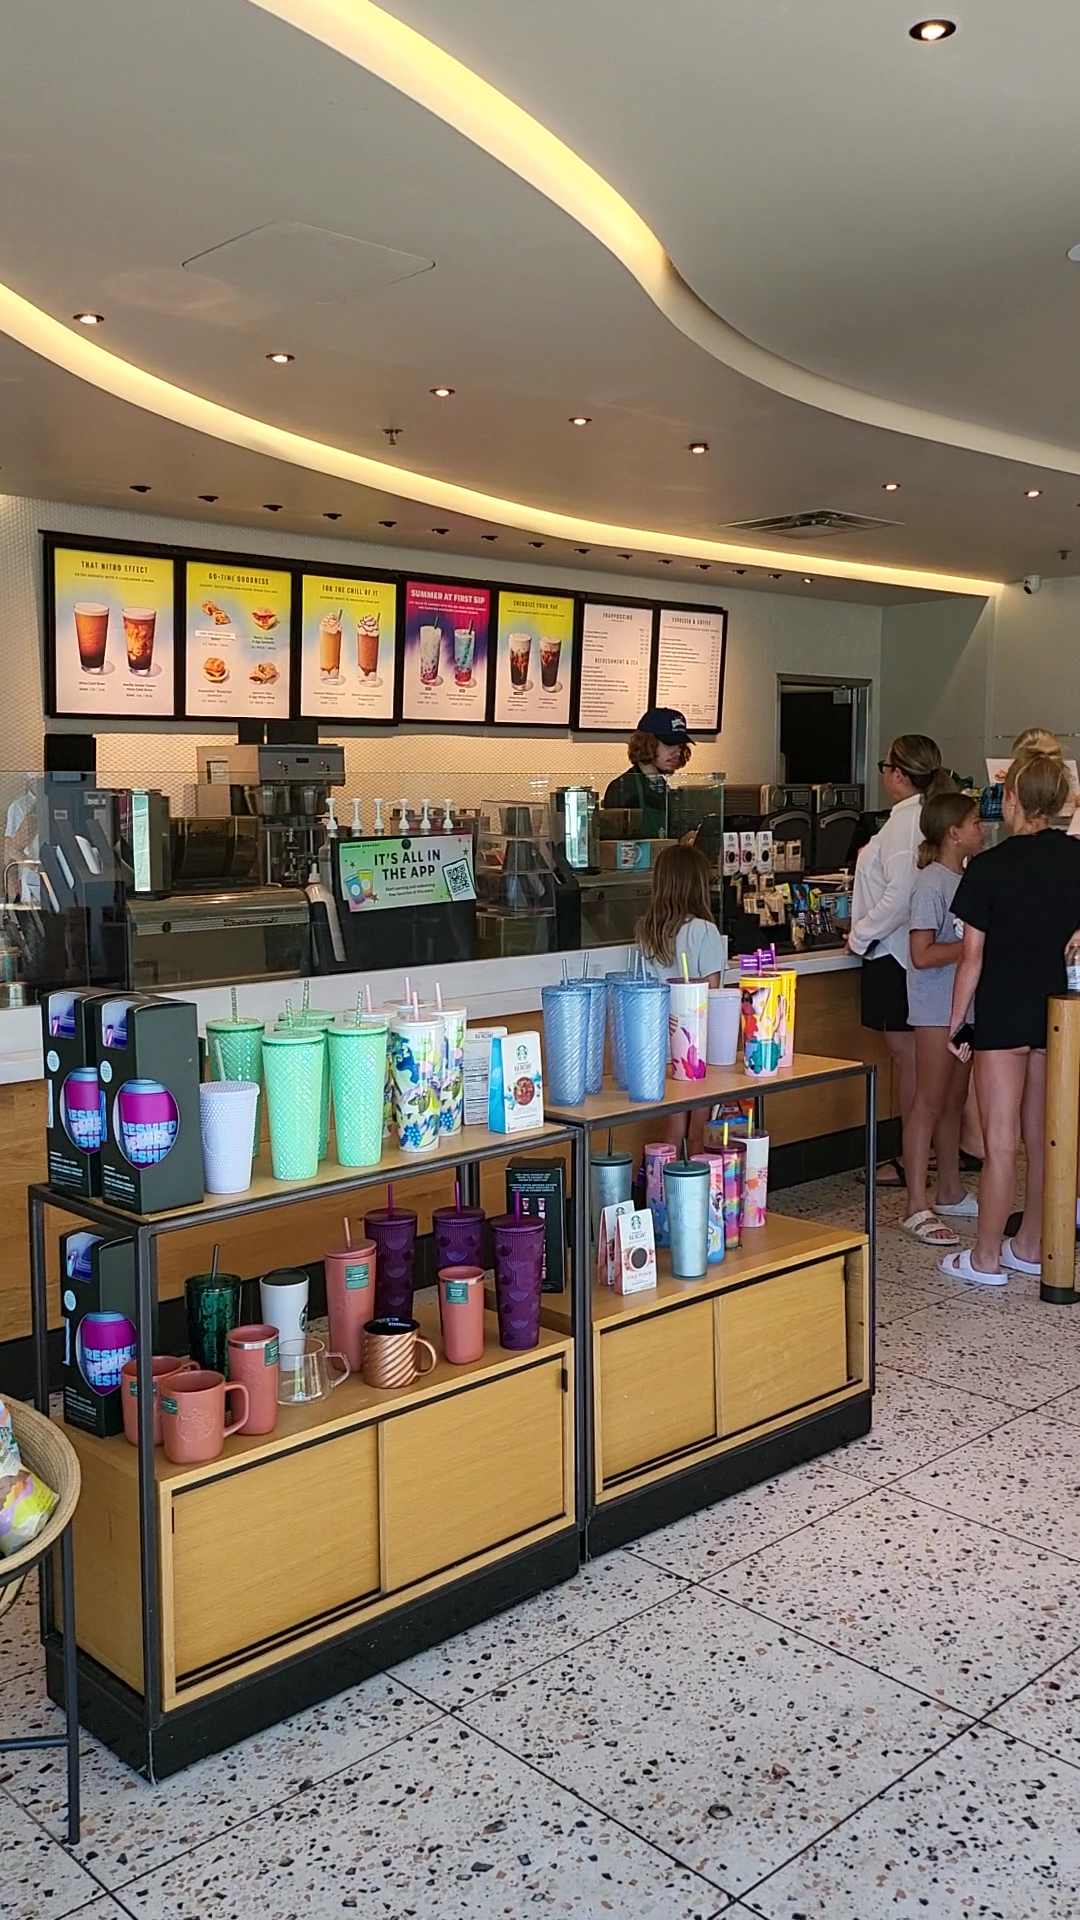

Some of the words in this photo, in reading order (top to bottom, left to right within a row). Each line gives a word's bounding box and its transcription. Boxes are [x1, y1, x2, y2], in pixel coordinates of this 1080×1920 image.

[81, 561, 98, 569] THAT
[101, 563, 122, 571] NITRO
[124, 565, 149, 574] EFFECT
[237, 575, 269, 585] GOODNESS
[322, 584, 333, 592] FOR
[335, 585, 345, 593] THE
[347, 587, 363, 595] CHILL
[411, 589, 443, 600] SUMMER
[443, 593, 453, 601] AT
[453, 594, 473, 603] FIRST
[473, 596, 485, 604] SIP
[602, 612, 633, 620] FRAPPUCCINO
[374, 852, 399, 866] IT'S
[402, 850, 424, 863] ALL
[427, 849, 441, 861] IN
[381, 867, 406, 881] THE
[410, 865, 435, 879] APP
